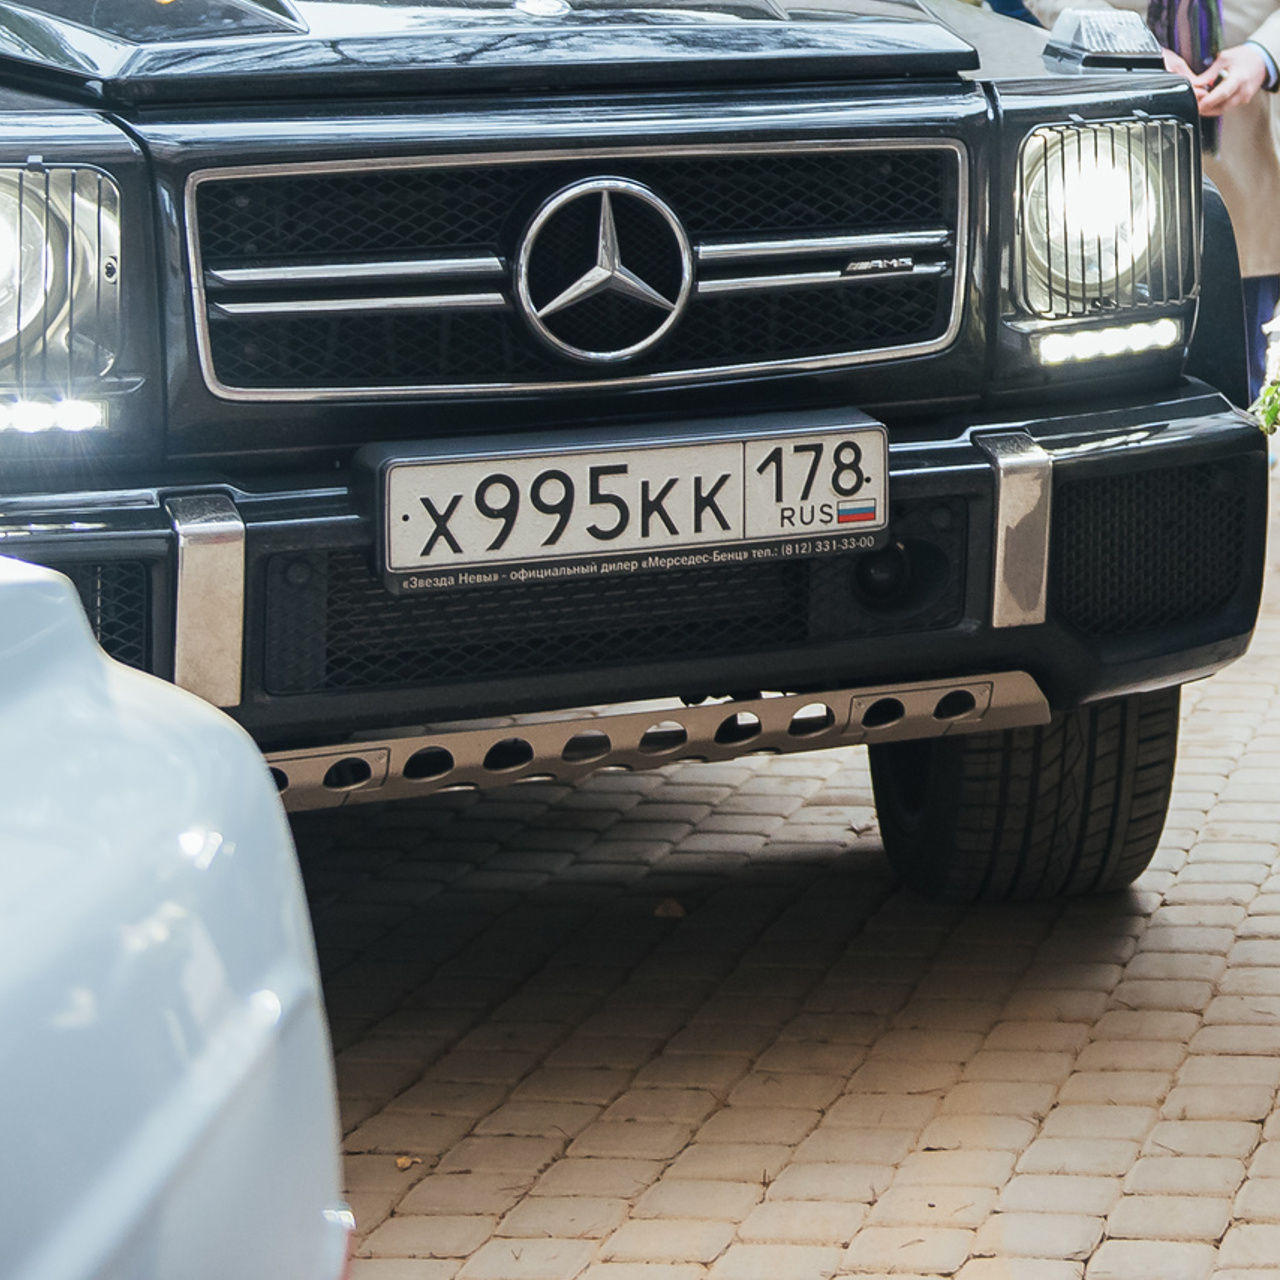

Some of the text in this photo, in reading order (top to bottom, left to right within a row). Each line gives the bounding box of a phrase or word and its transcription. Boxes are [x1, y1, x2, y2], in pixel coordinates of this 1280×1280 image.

[756, 441, 864, 503] 178
[780, 503, 834, 528] RUS
[509, 561, 598, 581] официальный
[600, 557, 638, 574] дилер
[780, 543, 812, 557] (812)
[814, 536, 875, 554] 331-33-00
